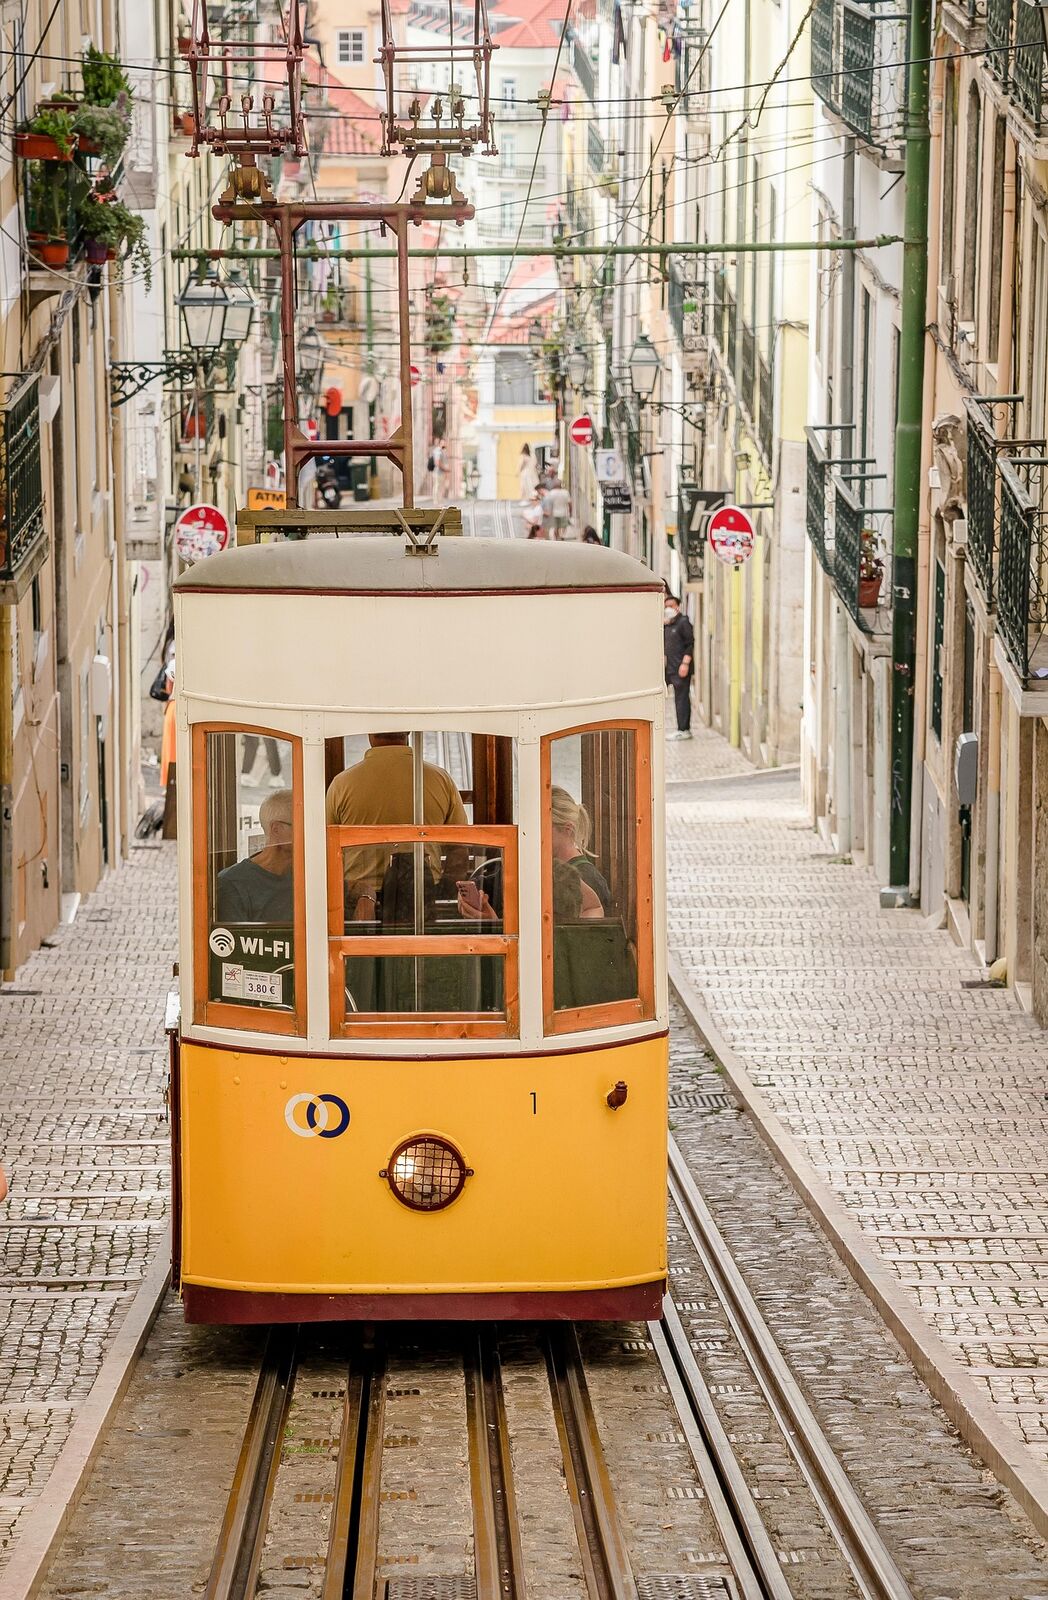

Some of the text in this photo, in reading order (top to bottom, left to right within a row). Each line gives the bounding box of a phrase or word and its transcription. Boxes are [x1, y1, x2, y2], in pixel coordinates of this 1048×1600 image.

[255, 492, 284, 502] ATM
[240, 936, 290, 959] WI-FI
[248, 982, 267, 994] 3.80
[269, 985, 276, 995] €
[529, 1092, 537, 1115] 1
